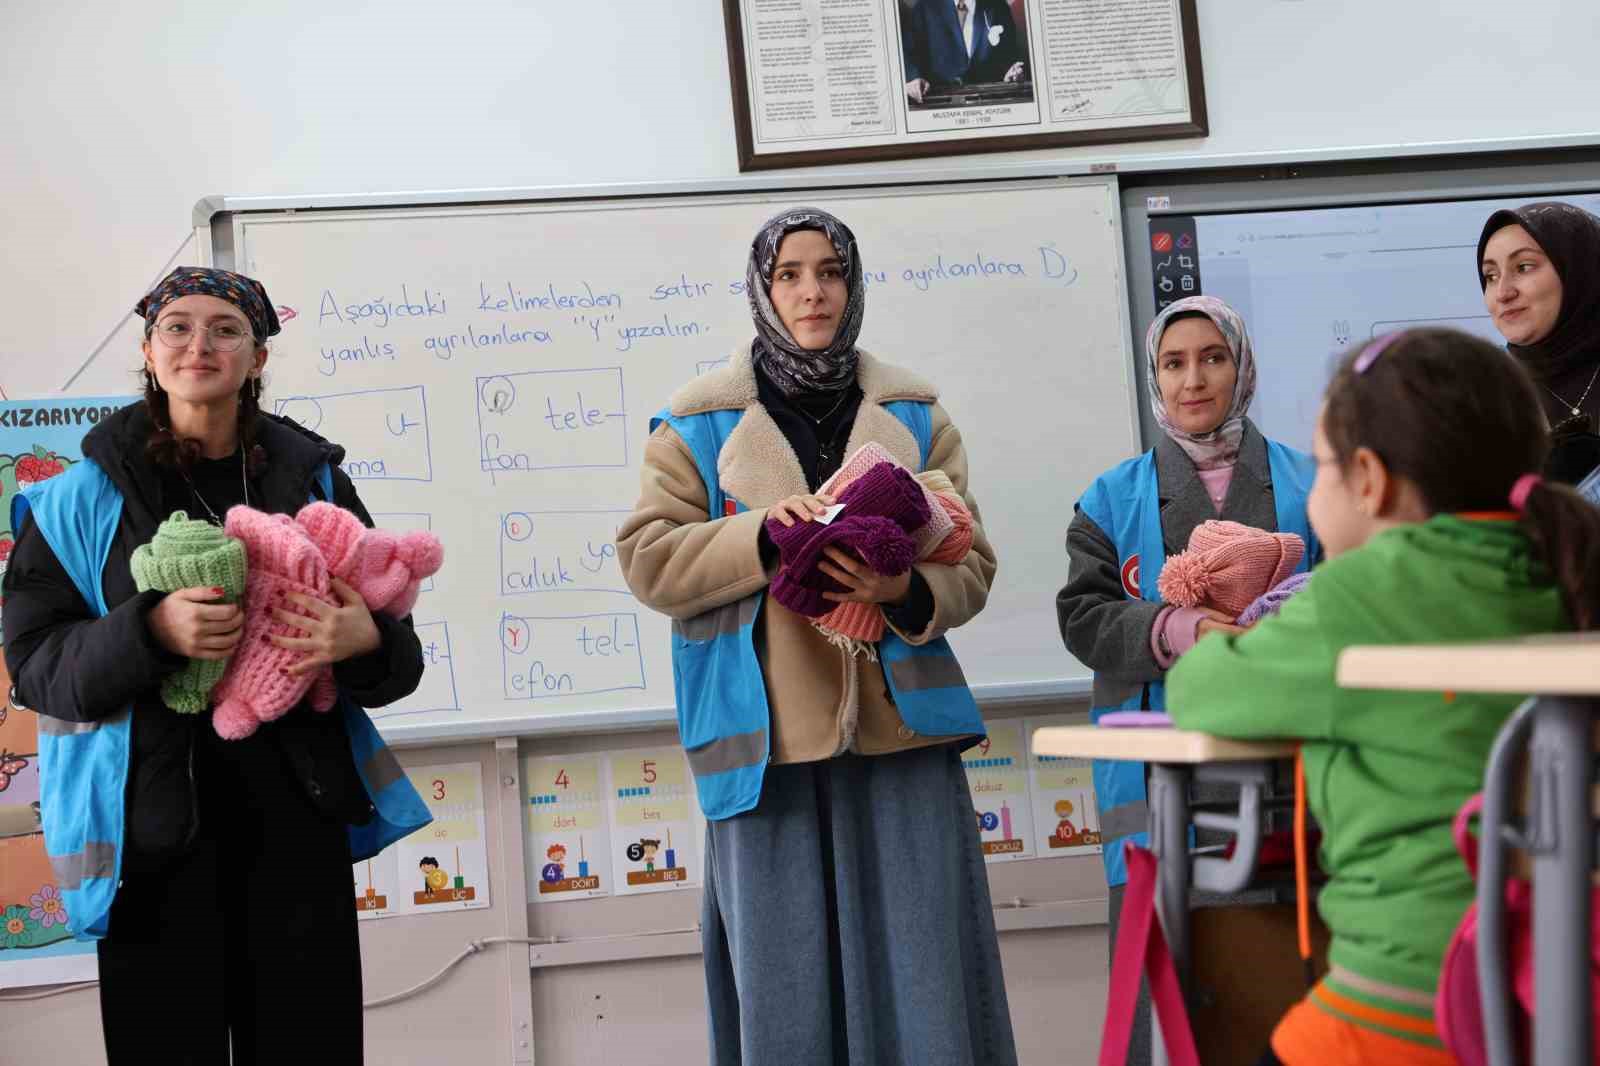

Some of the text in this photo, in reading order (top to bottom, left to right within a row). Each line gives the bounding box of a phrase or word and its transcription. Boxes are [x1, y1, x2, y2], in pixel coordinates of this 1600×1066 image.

[319, 284, 447, 328] Aşağıdaki
[478, 280, 622, 312] kelimelerden
[650, 273, 713, 300] satır
[902, 252, 1026, 291] ayrılanlara
[318, 335, 395, 376] yanlış
[424, 323, 553, 360] ayrılanlara
[480, 433, 531, 485] fon
[506, 556, 574, 589] culuk
[507, 627, 521, 647] Y
[575, 617, 635, 656] tel-
[511, 661, 574, 698] efon
[554, 768, 570, 789] 4
[642, 759, 657, 783] 5
[431, 779, 446, 801] 3
[983, 813, 993, 828] 9
[1059, 826, 1072, 840] 10
[631, 845, 640, 858] 5
[546, 865, 556, 880] 4
